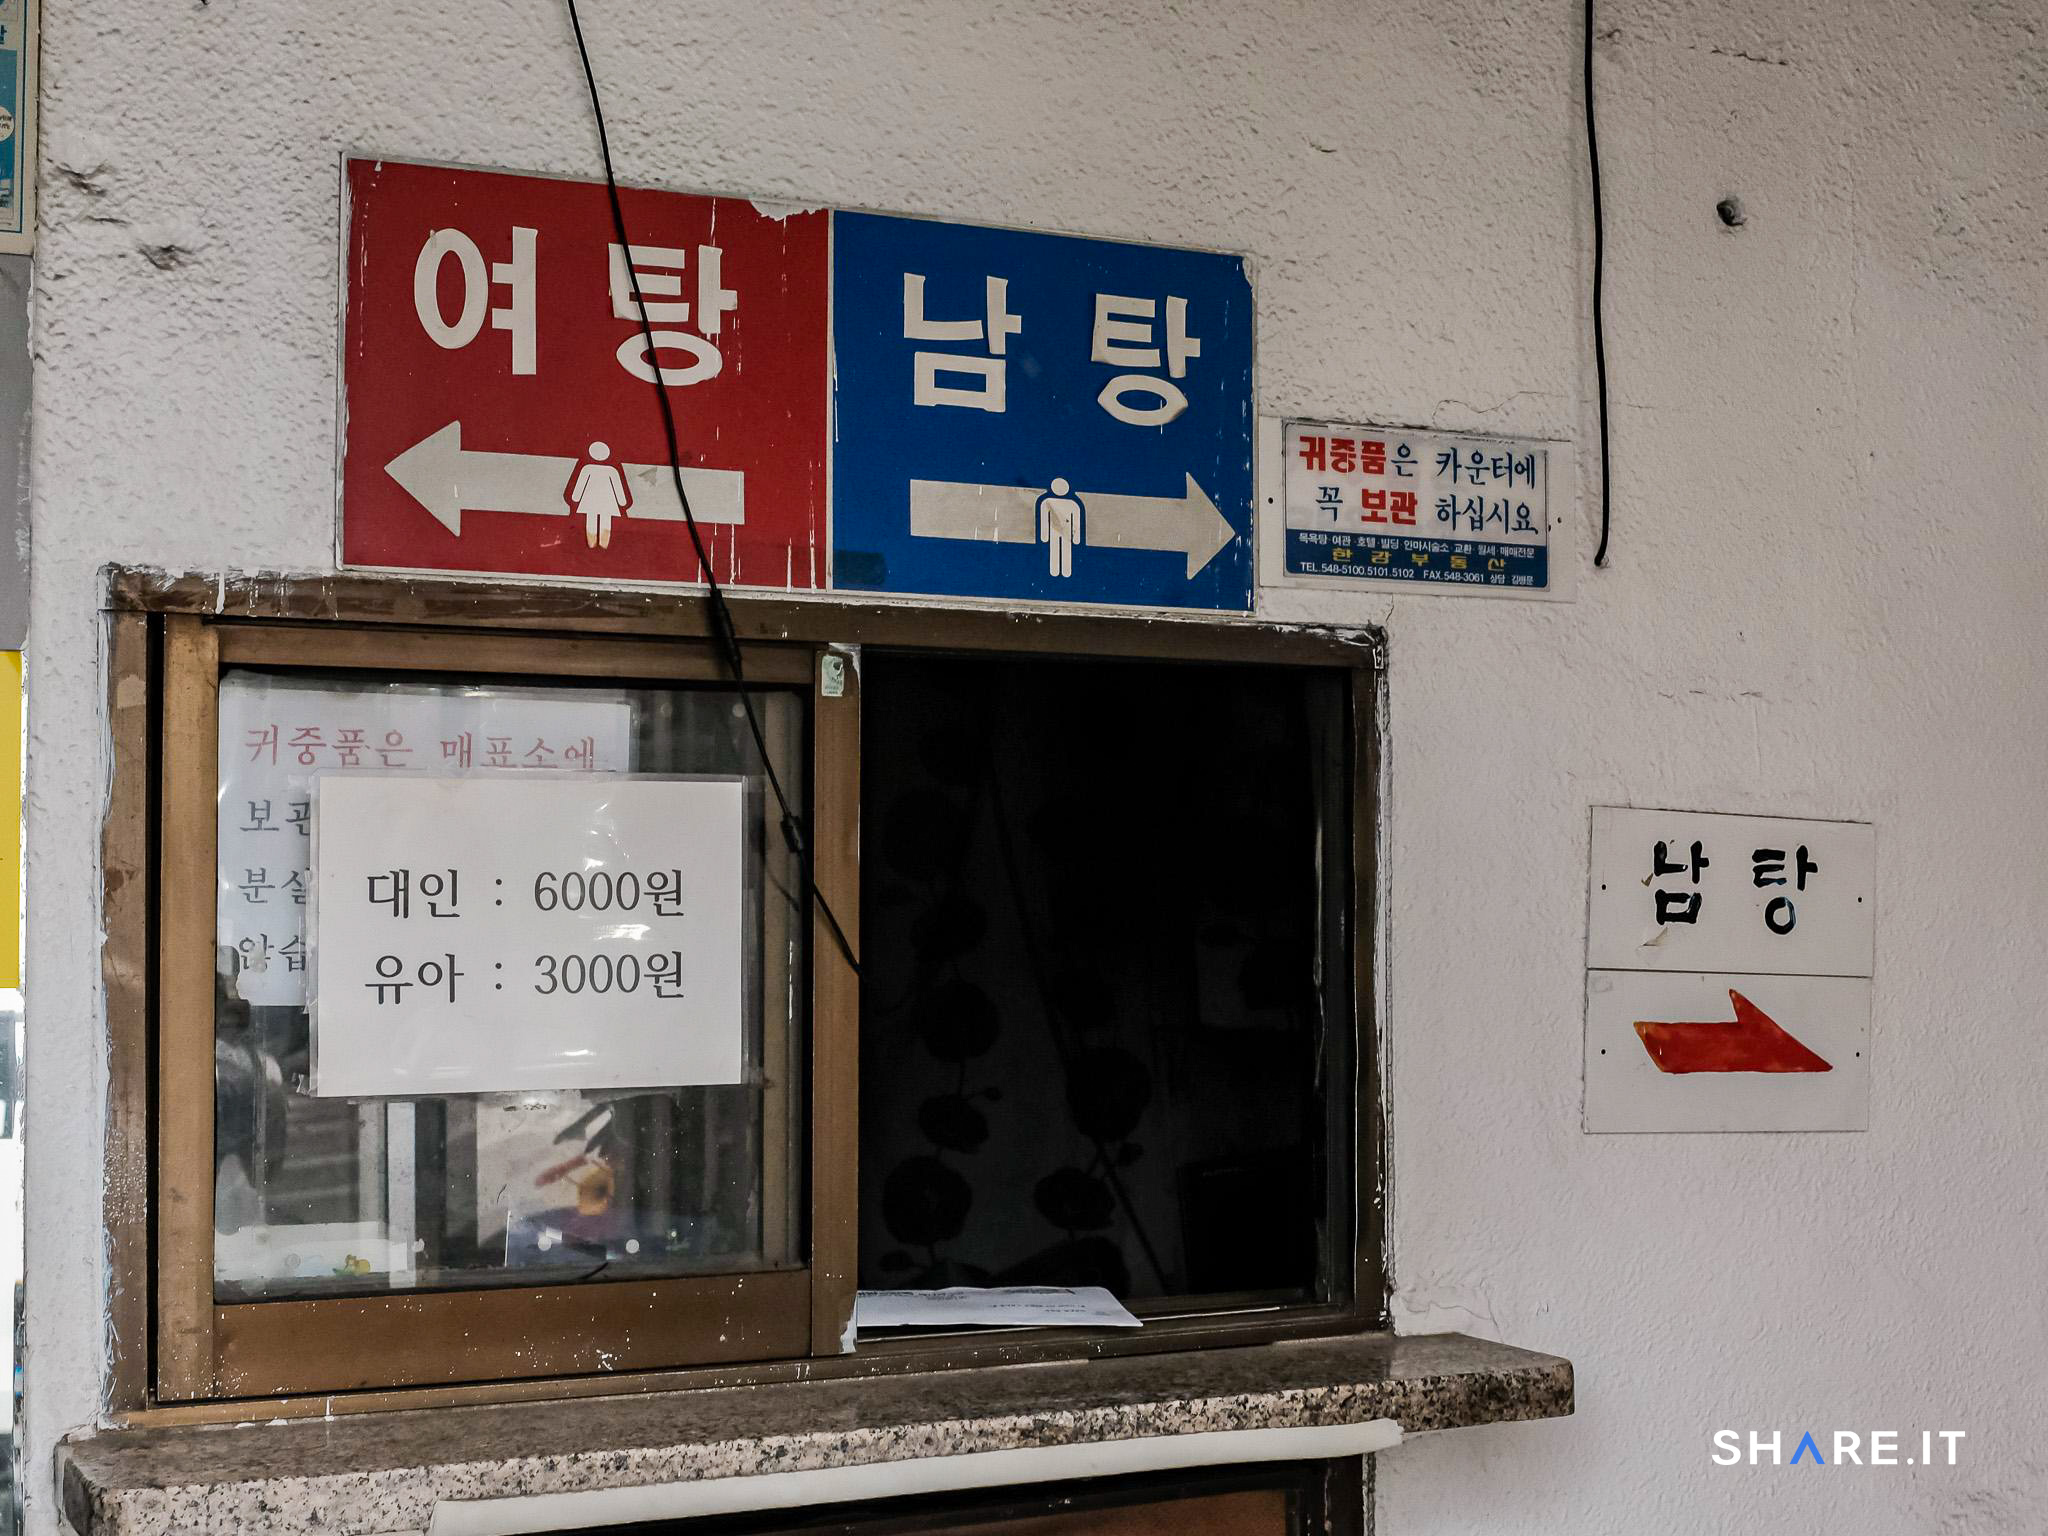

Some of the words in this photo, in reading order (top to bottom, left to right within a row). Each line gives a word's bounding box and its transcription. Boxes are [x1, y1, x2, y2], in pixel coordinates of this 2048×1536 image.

[903, 272, 1201, 427] 남탕
[1299, 435, 1418, 476] 귀중품은
[1434, 447, 1536, 490] 카운터에
[1315, 486, 1344, 523] 꼭
[1361, 488, 1418, 526] 보관
[1434, 493, 1539, 535] 하십시요
[245, 724, 414, 768] 귀중품은
[439, 730, 596, 769] 매표소에
[366, 869, 461, 919] 대인
[533, 869, 685, 918] 6000원
[1653, 840, 1818, 935] 남탕
[364, 953, 465, 1006] 유아
[533, 950, 685, 1000] 3000원
